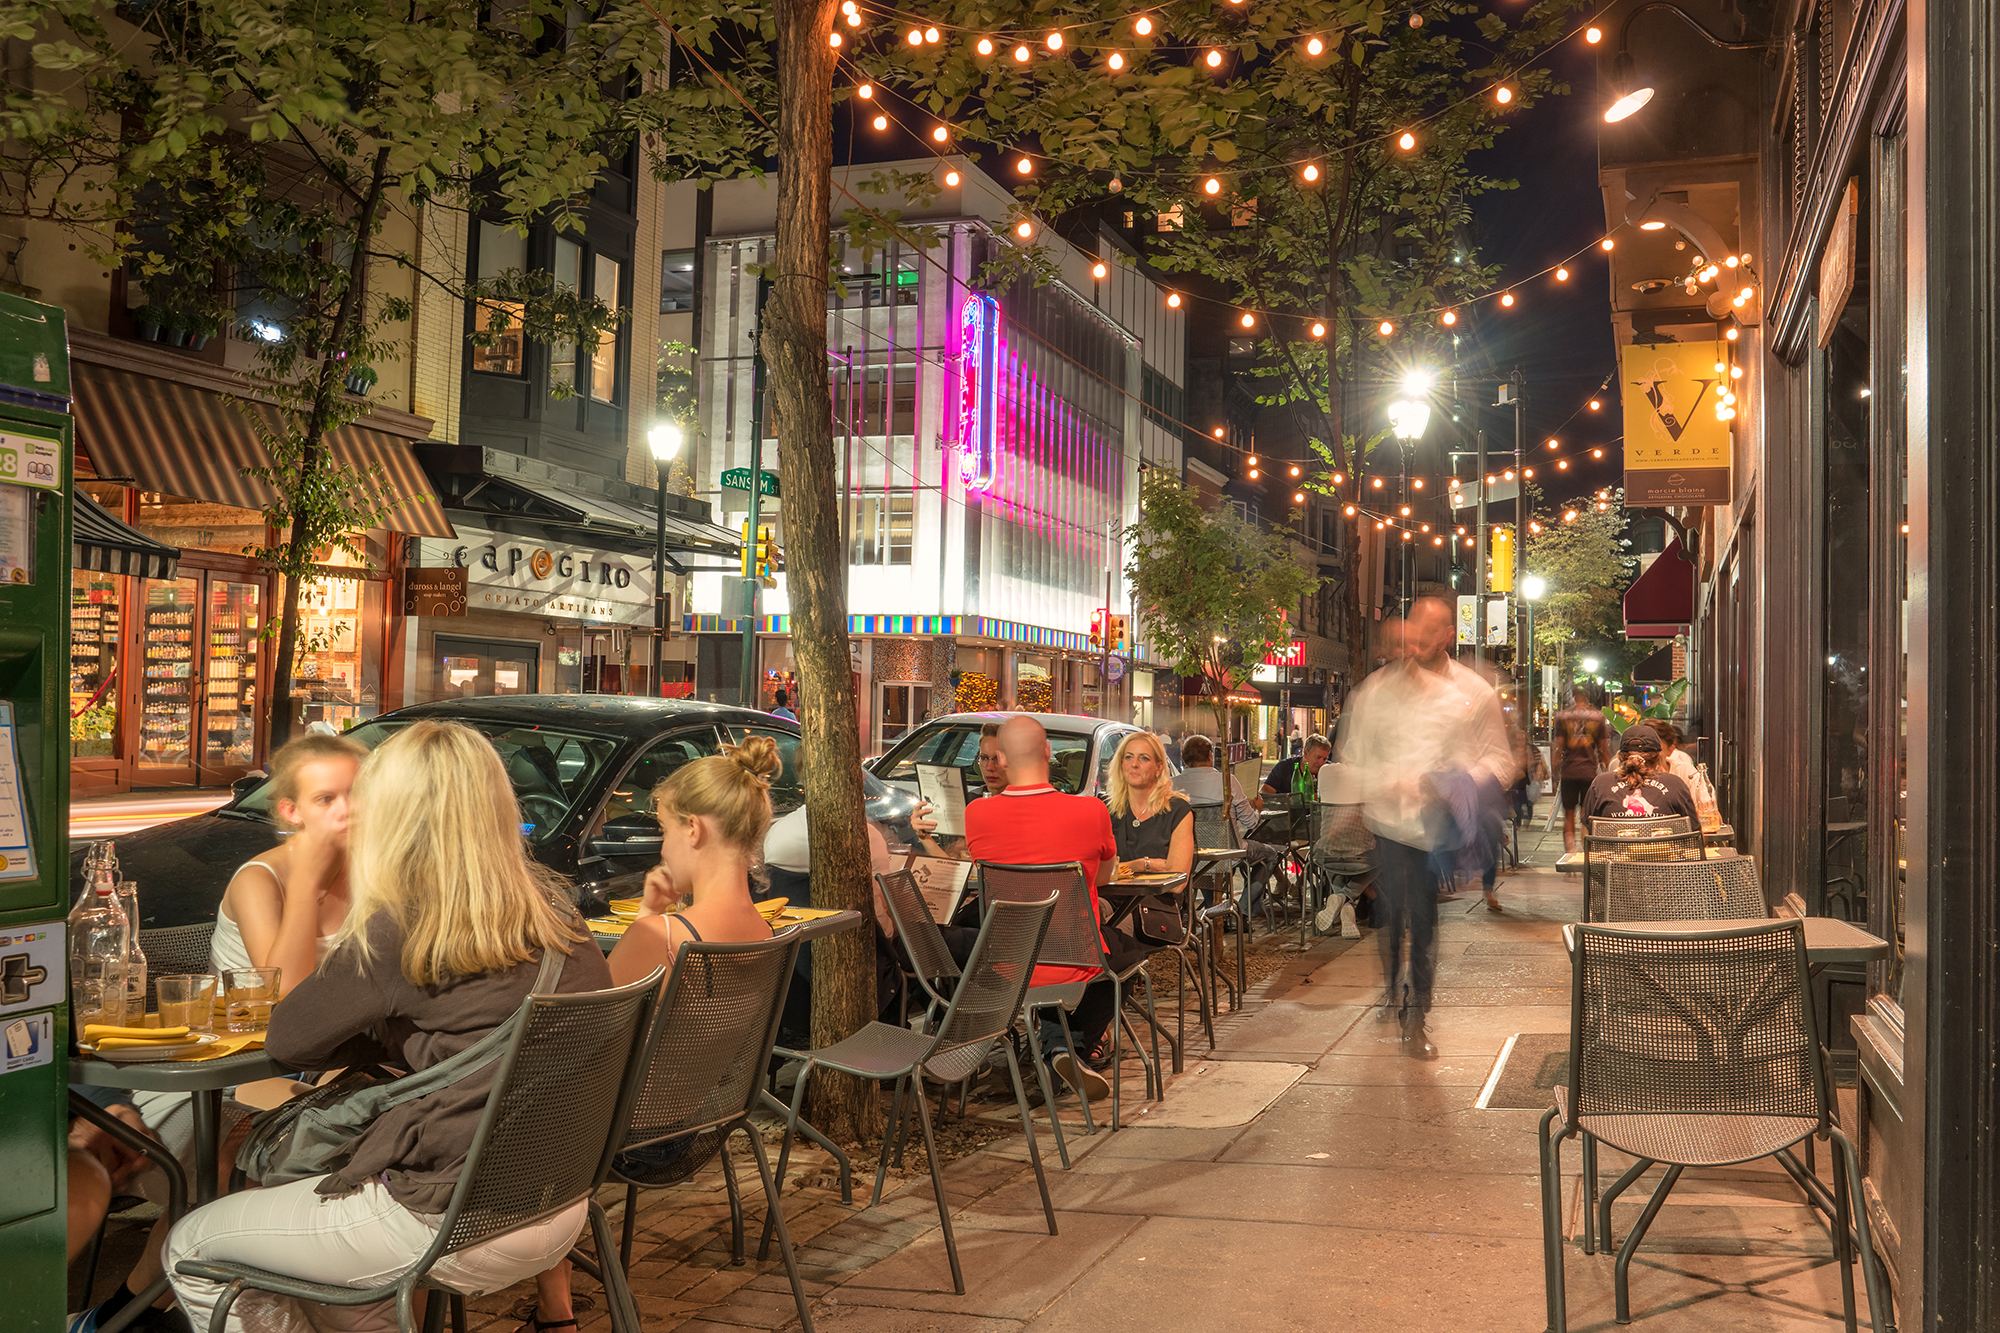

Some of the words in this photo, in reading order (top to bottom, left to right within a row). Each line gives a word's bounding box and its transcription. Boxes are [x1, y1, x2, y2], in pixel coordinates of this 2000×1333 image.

[725, 474, 768, 492] SANSM
[409, 582, 433, 590] duross
[440, 582, 462, 592] langel
[485, 593, 540, 607] GELATO
[550, 601, 613, 616] ARTISANS
[220, 655, 246, 663] SALON
